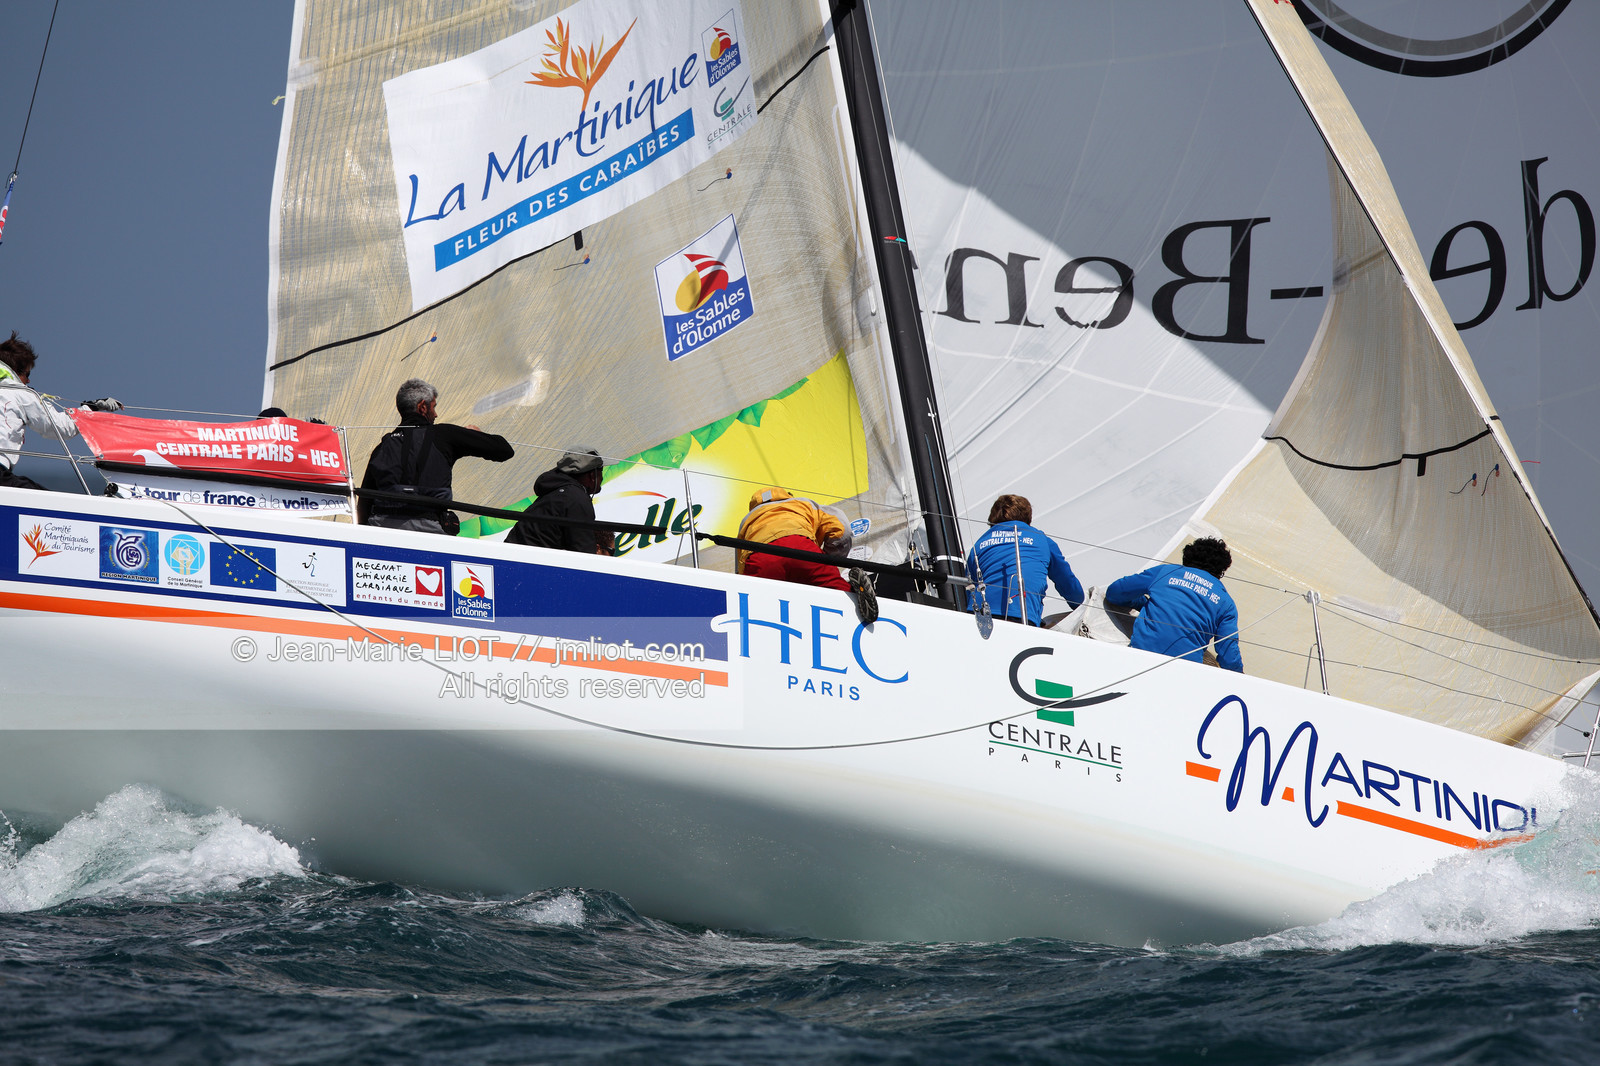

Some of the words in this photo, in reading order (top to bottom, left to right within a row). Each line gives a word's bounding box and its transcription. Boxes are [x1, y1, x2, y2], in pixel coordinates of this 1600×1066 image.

[718, 48, 738, 67] Sables
[710, 59, 737, 83] d'Olonne
[707, 103, 751, 142] CENTRALE
[404, 174, 466, 228] La
[482, 52, 700, 200] Martinique
[454, 211, 518, 256] FLEUR
[529, 186, 569, 217] DES
[580, 125, 680, 192] CARAÏBES
[676, 318, 695, 335] les
[695, 287, 745, 327] Sables
[673, 308, 741, 354] d'Olonne
[197, 425, 299, 443] MARTINIQUE
[156, 442, 242, 459] CENTRALE
[247, 444, 294, 463] PARIS
[310, 449, 340, 468] HEC
[144, 487, 180, 501] tour
[183, 490, 200, 503] de
[203, 490, 256, 506] france
[259, 493, 267, 508] à
[270, 494, 280, 509] la
[282, 497, 319, 510] voile
[44, 522, 72, 534] Comité
[44, 532, 89, 546] Martiniquais
[51, 541, 61, 550] du
[62, 542, 95, 554] Tourisme
[980, 538, 1004, 549] CENTRALE
[1023, 537, 1034, 545] HEC
[123, 574, 157, 582] MARTINIQUE
[355, 561, 402, 572] MECENAT
[179, 581, 203, 589] Martinique
[1168, 577, 1195, 590] CENTRALE
[1193, 584, 1209, 597] PARIS
[1209, 592, 1221, 605] HEC
[1183, 571, 1214, 590] MARTINIQUE
[356, 593, 392, 602] enfants
[467, 599, 491, 609] Sables
[455, 606, 488, 618] d'Olonne
[718, 592, 909, 684] HEC
[787, 675, 861, 702] PARIS
[988, 720, 1122, 765] CENTRALE
[988, 746, 1122, 783] PARIS
[1197, 694, 1537, 829] MARTINIQ
